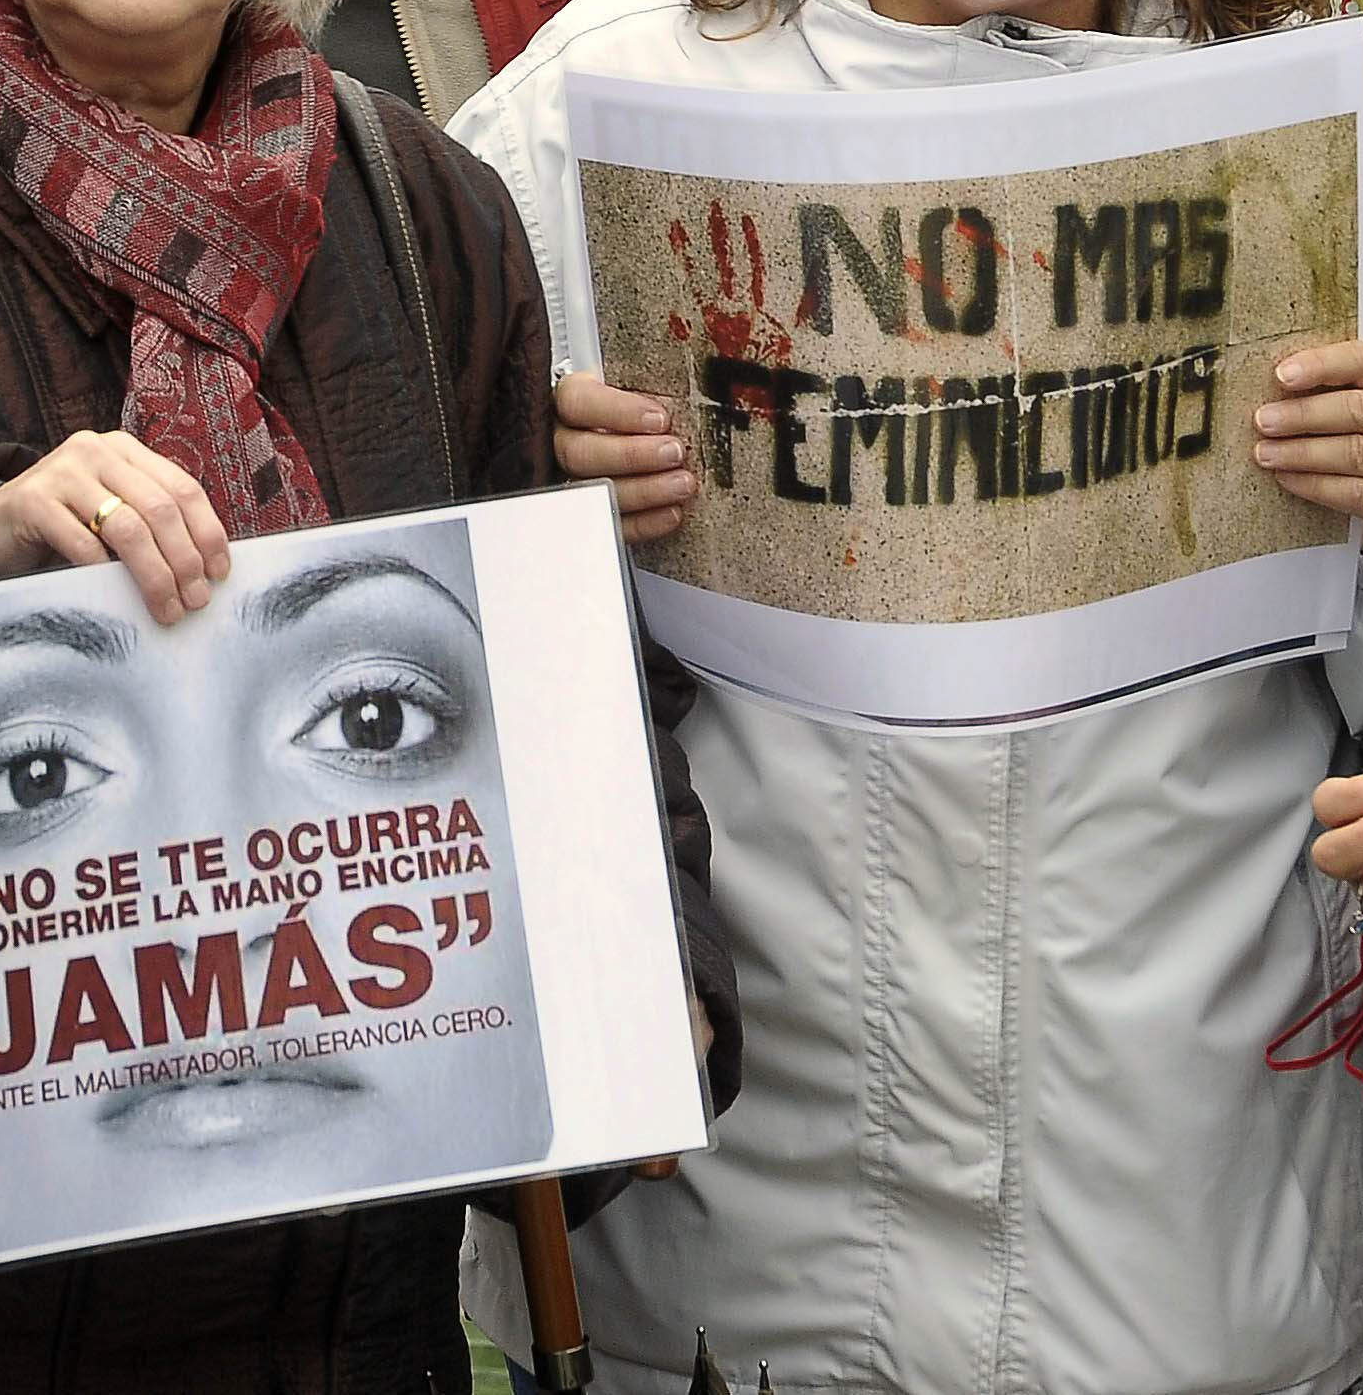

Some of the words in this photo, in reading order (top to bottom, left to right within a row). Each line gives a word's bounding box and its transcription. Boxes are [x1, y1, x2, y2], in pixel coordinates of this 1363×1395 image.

[797, 205, 998, 334] NO
[1054, 199, 1228, 327] MAS
[704, 346, 1220, 505] FEMINICIDIOS
[76, 850, 140, 897] SE
[158, 837, 227, 886] TE
[246, 798, 483, 870] OCURRA
[154, 889, 197, 923] LA
[213, 869, 323, 912] MANO
[338, 842, 489, 890] ENCIMA
[42, 1075, 69, 1101] EL
[75, 1046, 262, 1096] MALTRATADOR,
[268, 1020, 427, 1062] TOLERANCIA
[433, 1006, 512, 1035] CERO.
